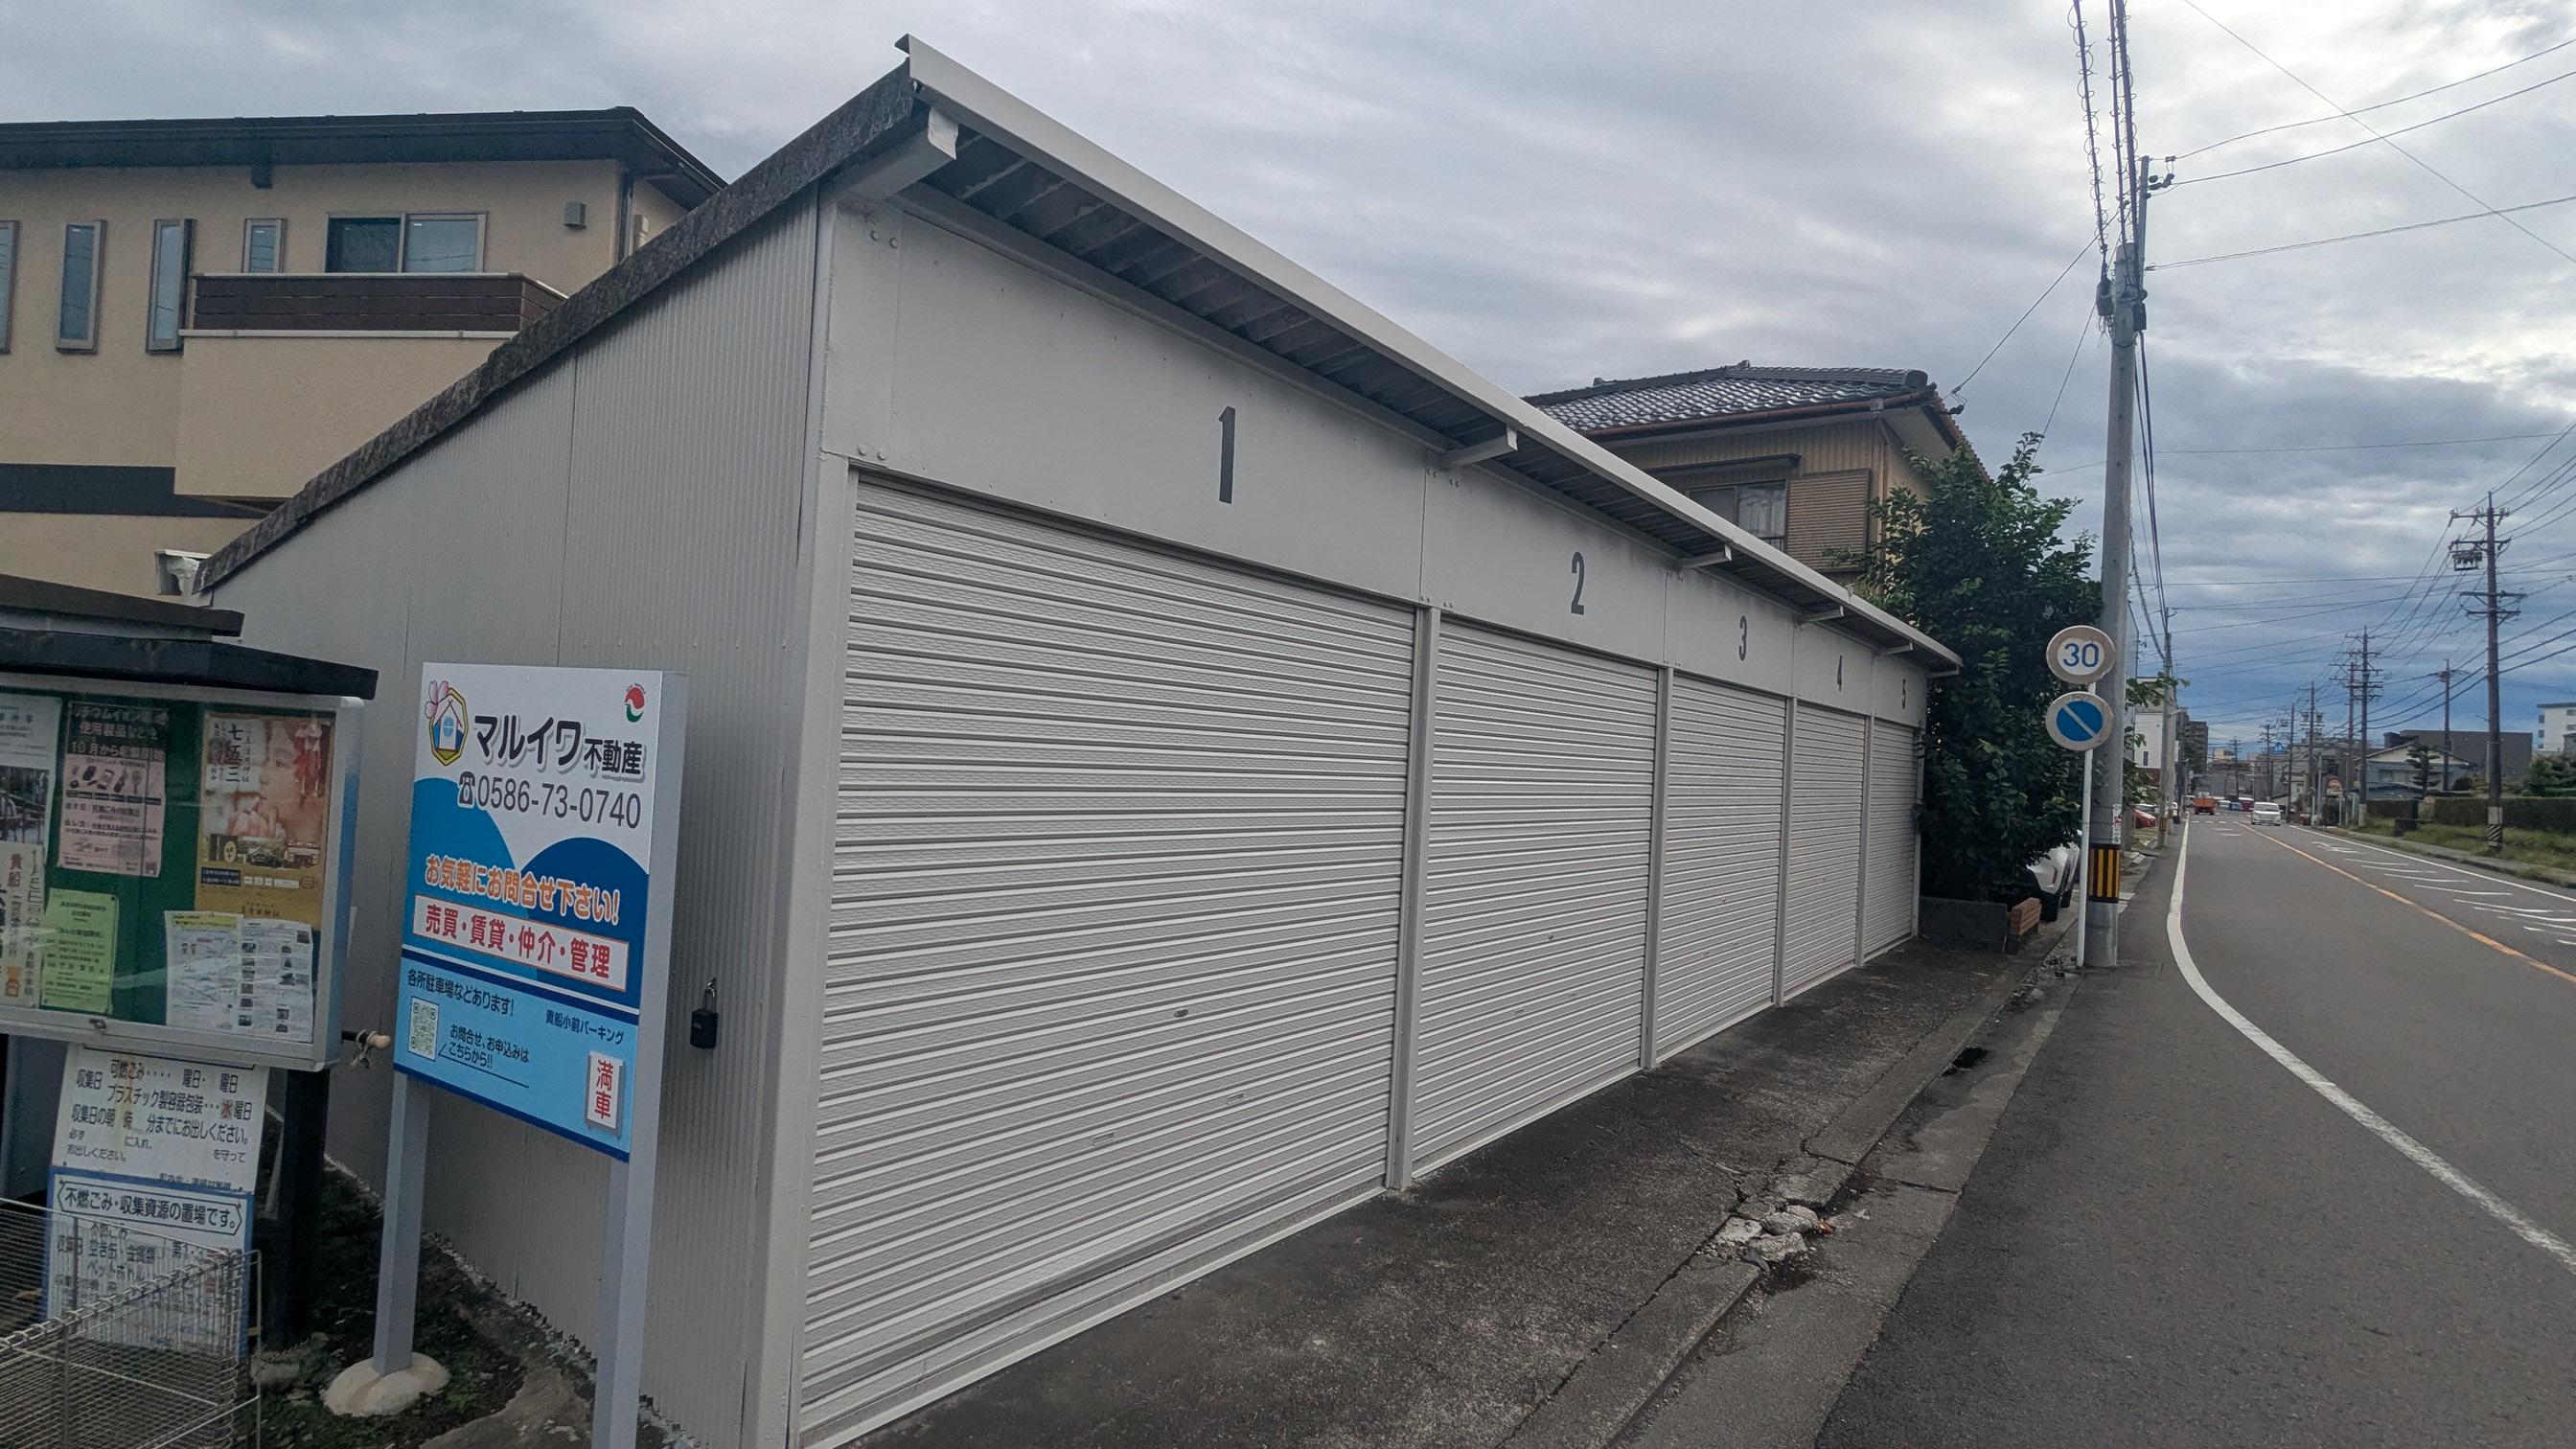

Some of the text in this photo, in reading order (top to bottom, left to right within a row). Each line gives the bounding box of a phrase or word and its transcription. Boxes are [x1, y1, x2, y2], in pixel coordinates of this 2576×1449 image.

[1218, 406, 1235, 503] 1
[1570, 551, 1585, 615] 2
[1738, 615, 1748, 662] 3
[2062, 642, 2099, 668] 30
[1836, 655, 1843, 692] 4
[1901, 678, 1907, 709] 5
[473, 714, 643, 775] マルイワ不動産
[478, 774, 641, 829] 0586-73-0740
[426, 904, 610, 979] 売買・賃貸・仲介・管理
[76, 1069, 104, 1090] 収集日
[219, 1072, 239, 1093] 曜日
[594, 1059, 614, 1119] 満車
